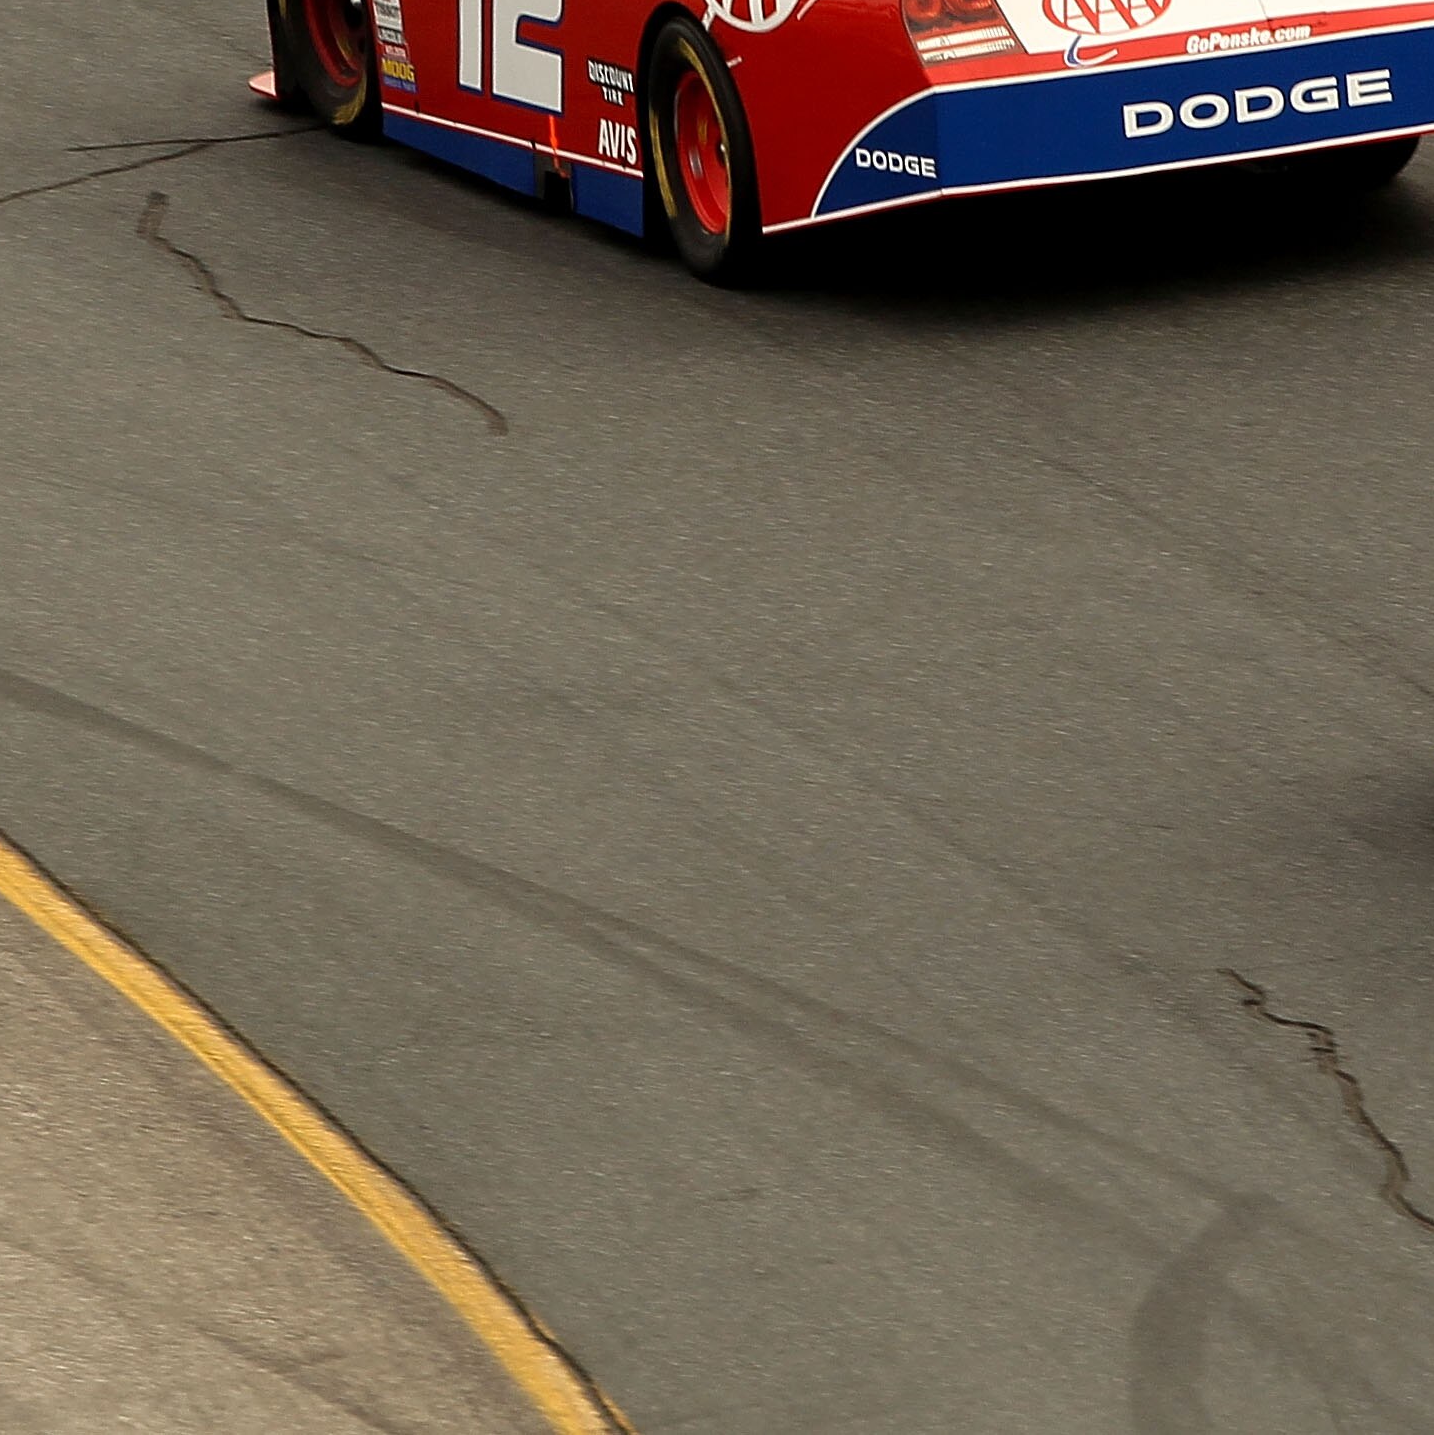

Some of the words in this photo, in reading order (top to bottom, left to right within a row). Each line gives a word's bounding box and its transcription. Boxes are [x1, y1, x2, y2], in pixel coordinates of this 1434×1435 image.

[1186, 25, 1312, 55] GoPenske.com
[586, 59, 635, 93] DISCOUNT
[601, 85, 625, 106] TIRE
[1123, 68, 1393, 140] DODGE
[597, 118, 638, 165] AVIS
[855, 148, 937, 178] DODGE
